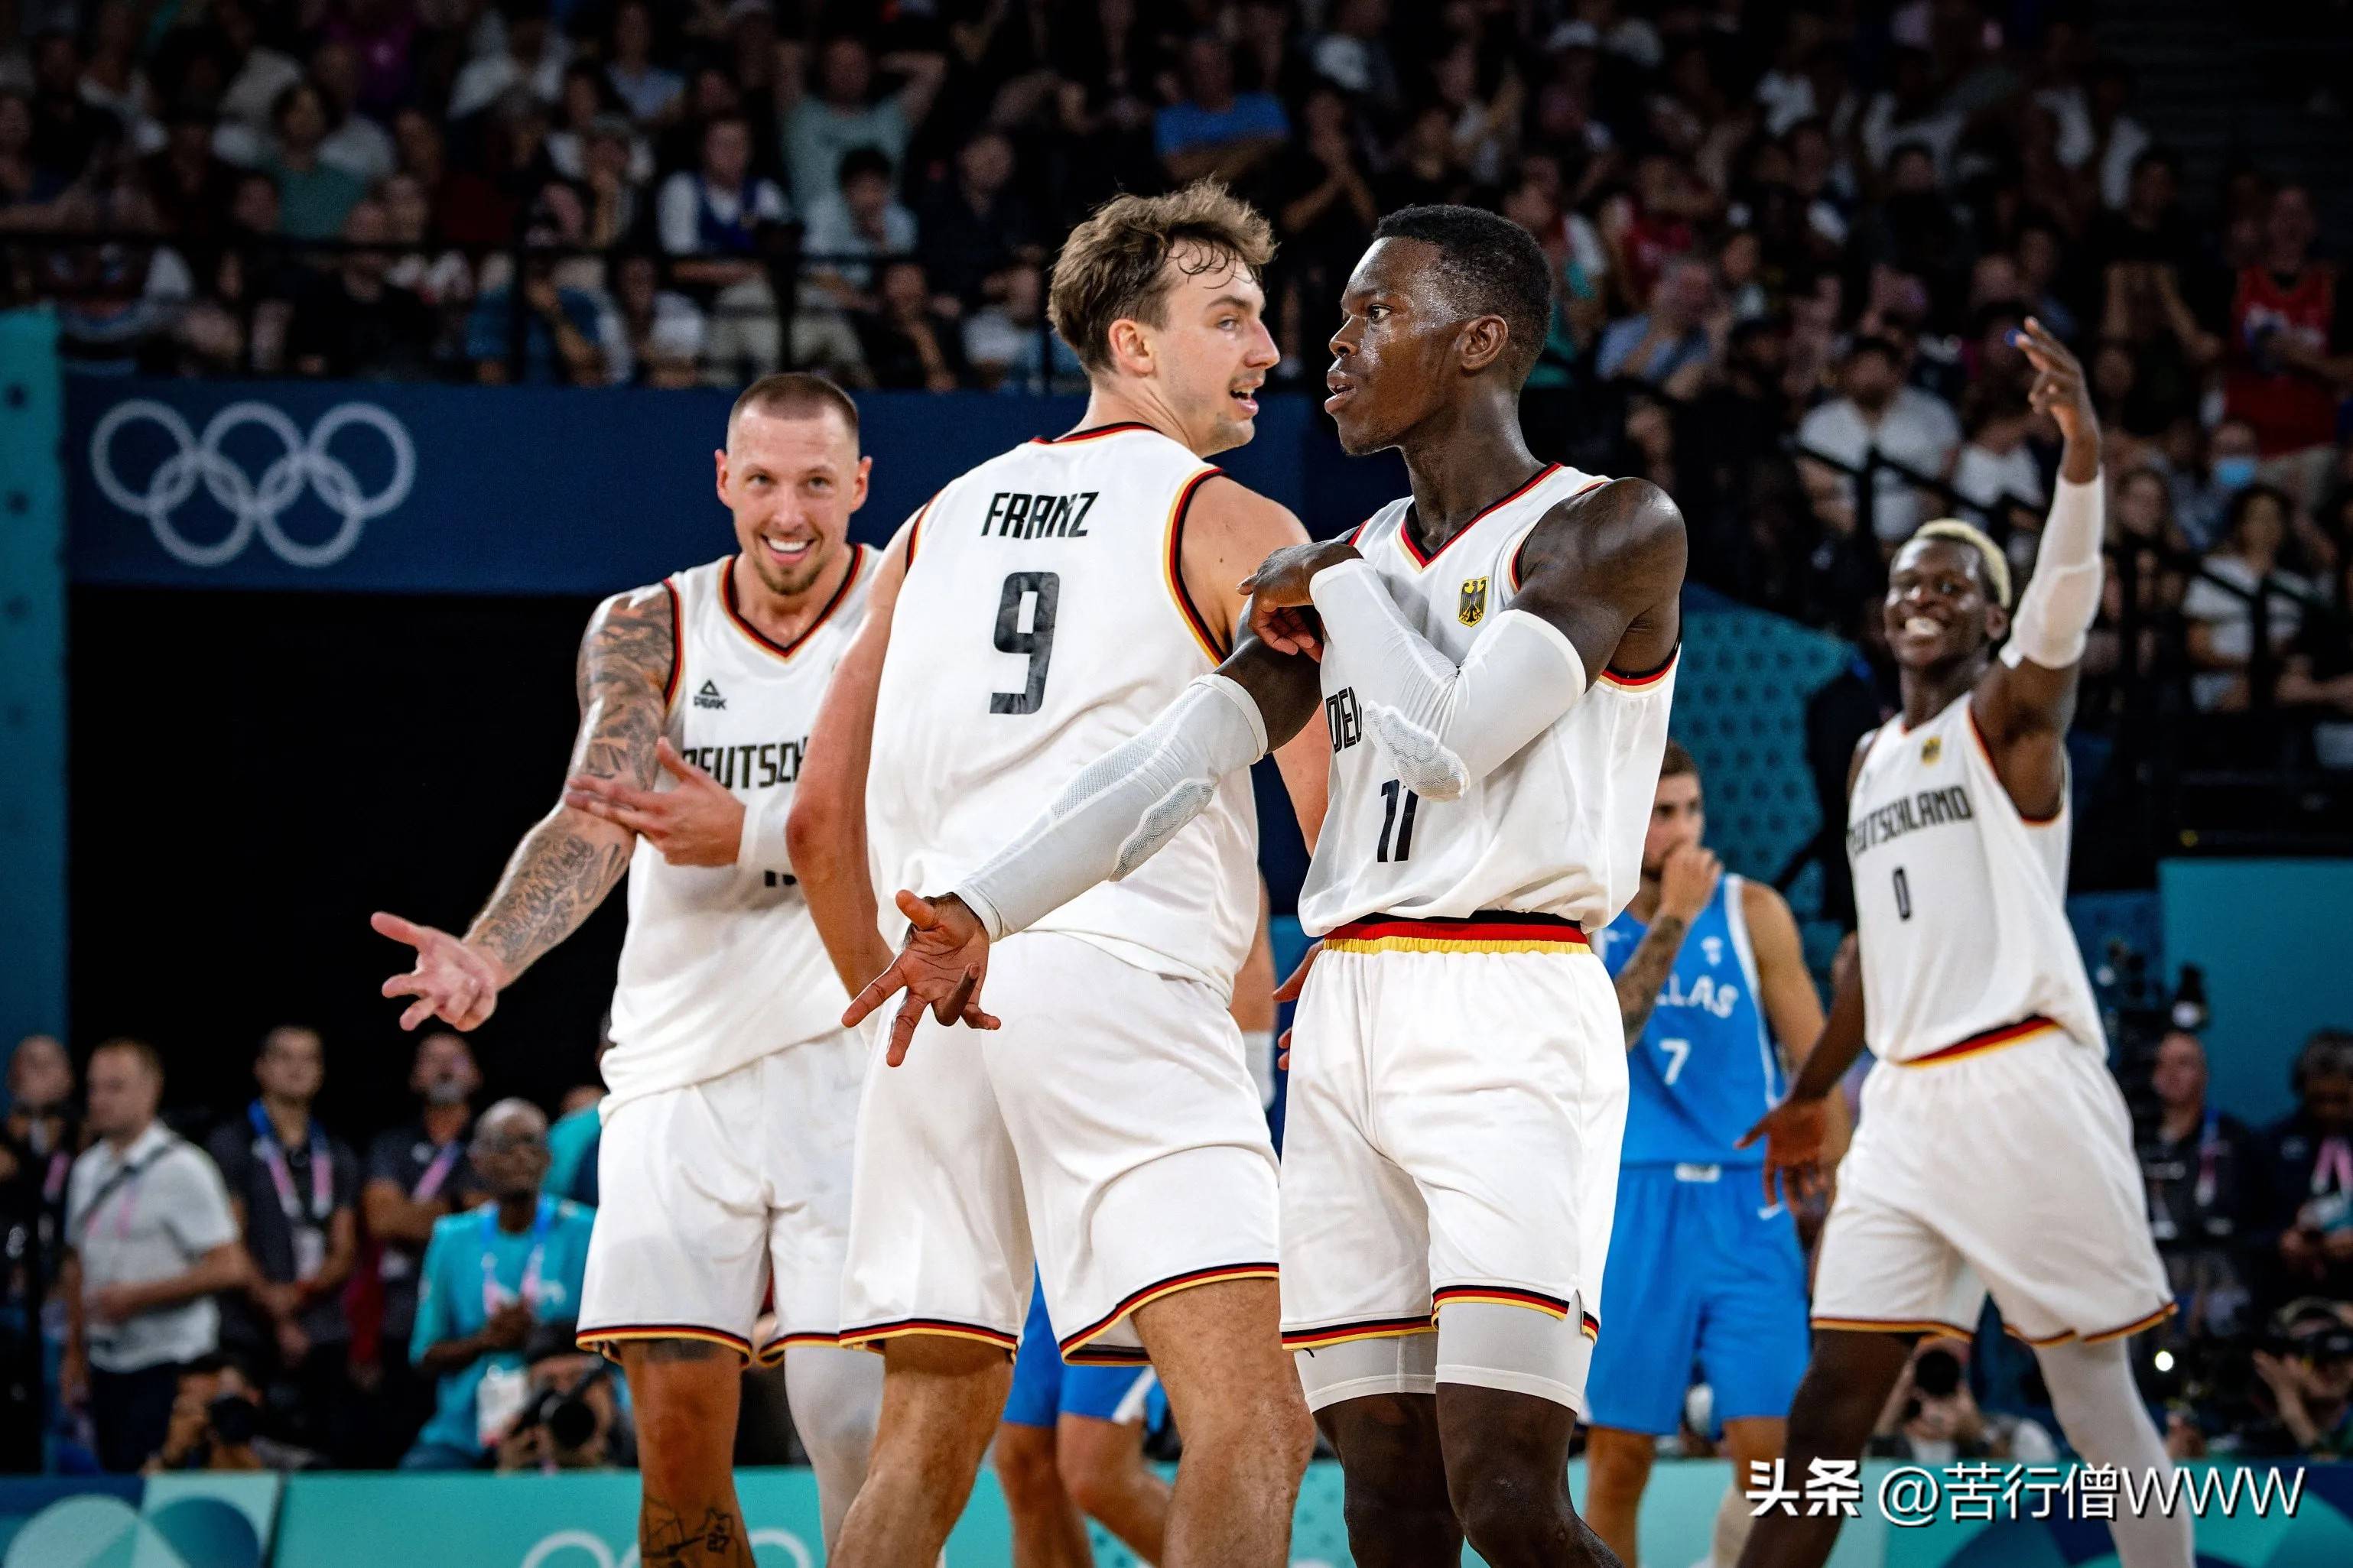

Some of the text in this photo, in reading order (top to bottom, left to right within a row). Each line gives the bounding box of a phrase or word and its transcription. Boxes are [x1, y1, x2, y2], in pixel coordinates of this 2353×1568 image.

[980, 492, 1100, 540] FRANZ
[990, 572, 1060, 714] 9
[694, 695, 727, 710] PEAK
[1376, 778, 1419, 862] 11
[1893, 865, 1911, 923] 0
[1659, 1037, 1692, 1086] 7
